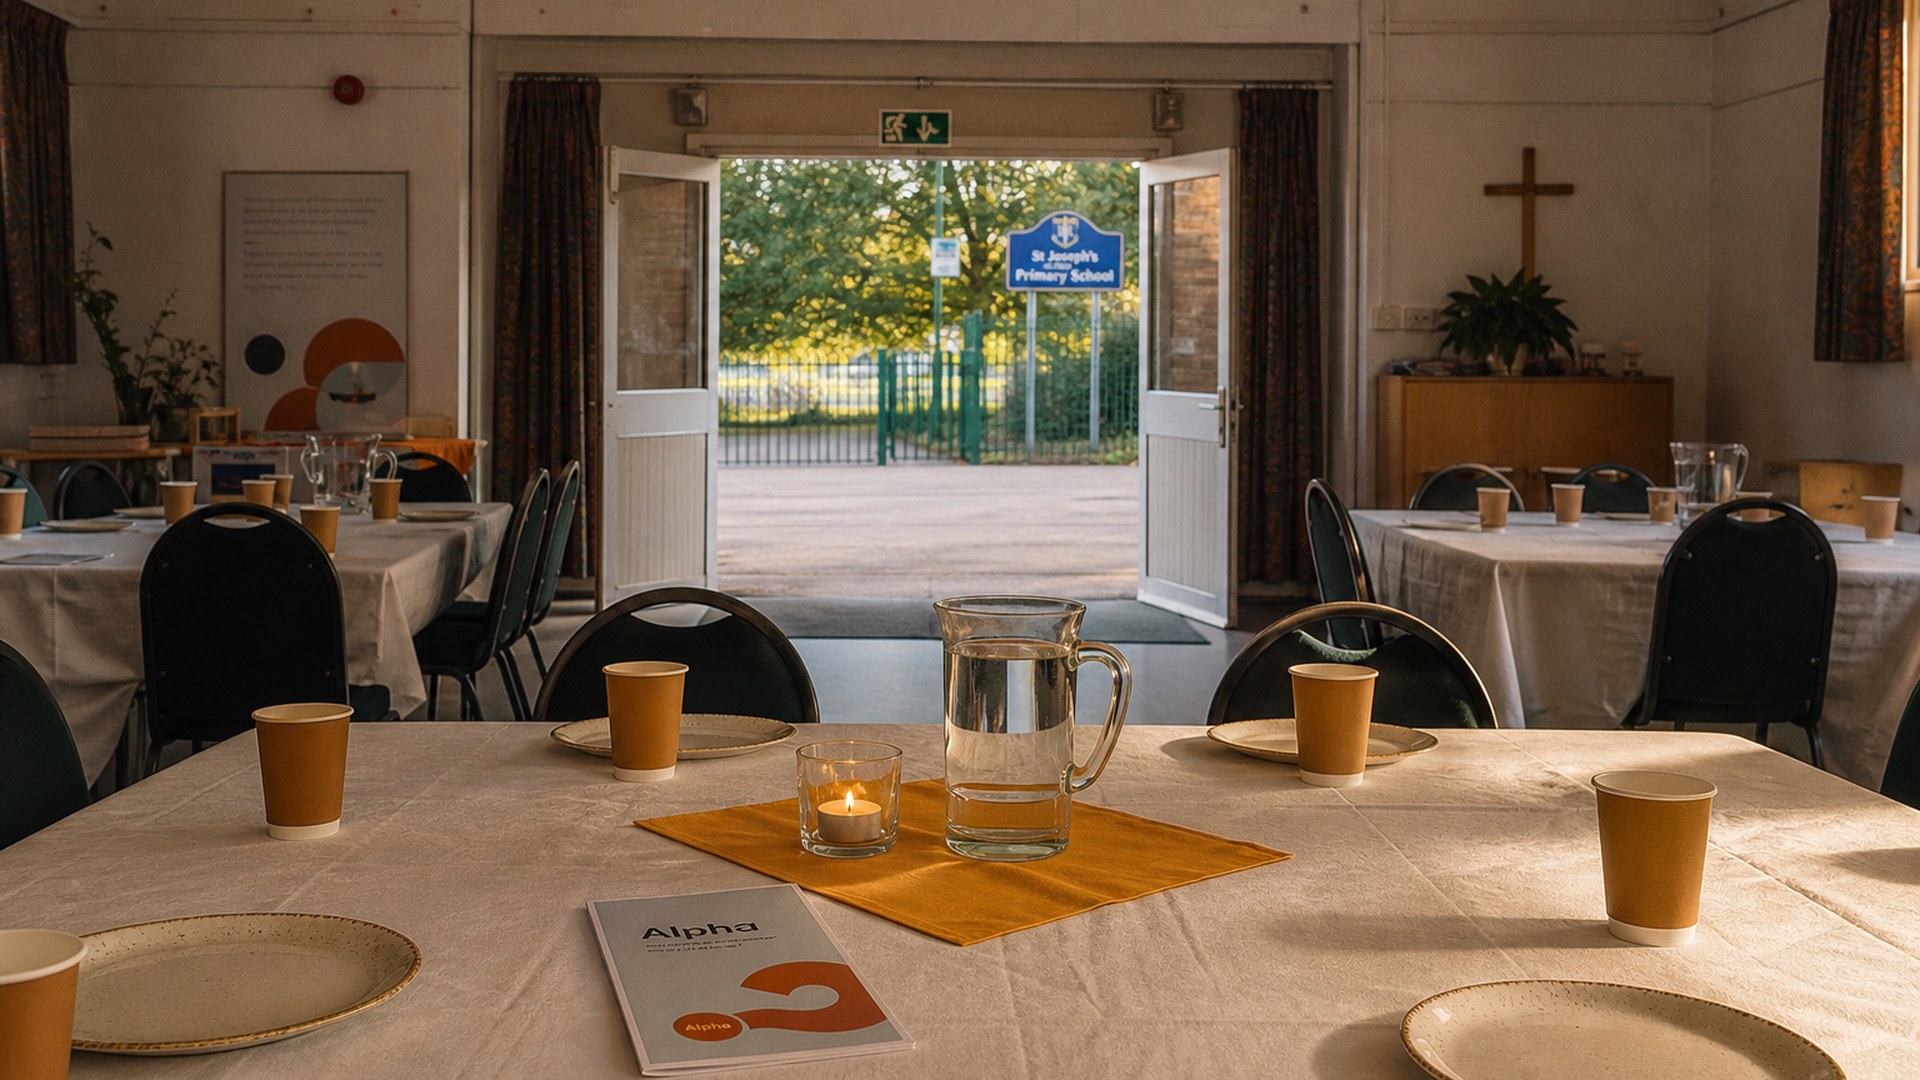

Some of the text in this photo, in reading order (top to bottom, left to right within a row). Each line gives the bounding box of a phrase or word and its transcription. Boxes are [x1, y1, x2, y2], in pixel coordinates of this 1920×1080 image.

[1031, 249, 1099, 264] St Joseph's
[1015, 268, 1115, 285] Primary School
[642, 922, 759, 940] Alpha
[685, 1022, 732, 1032] Alpha
